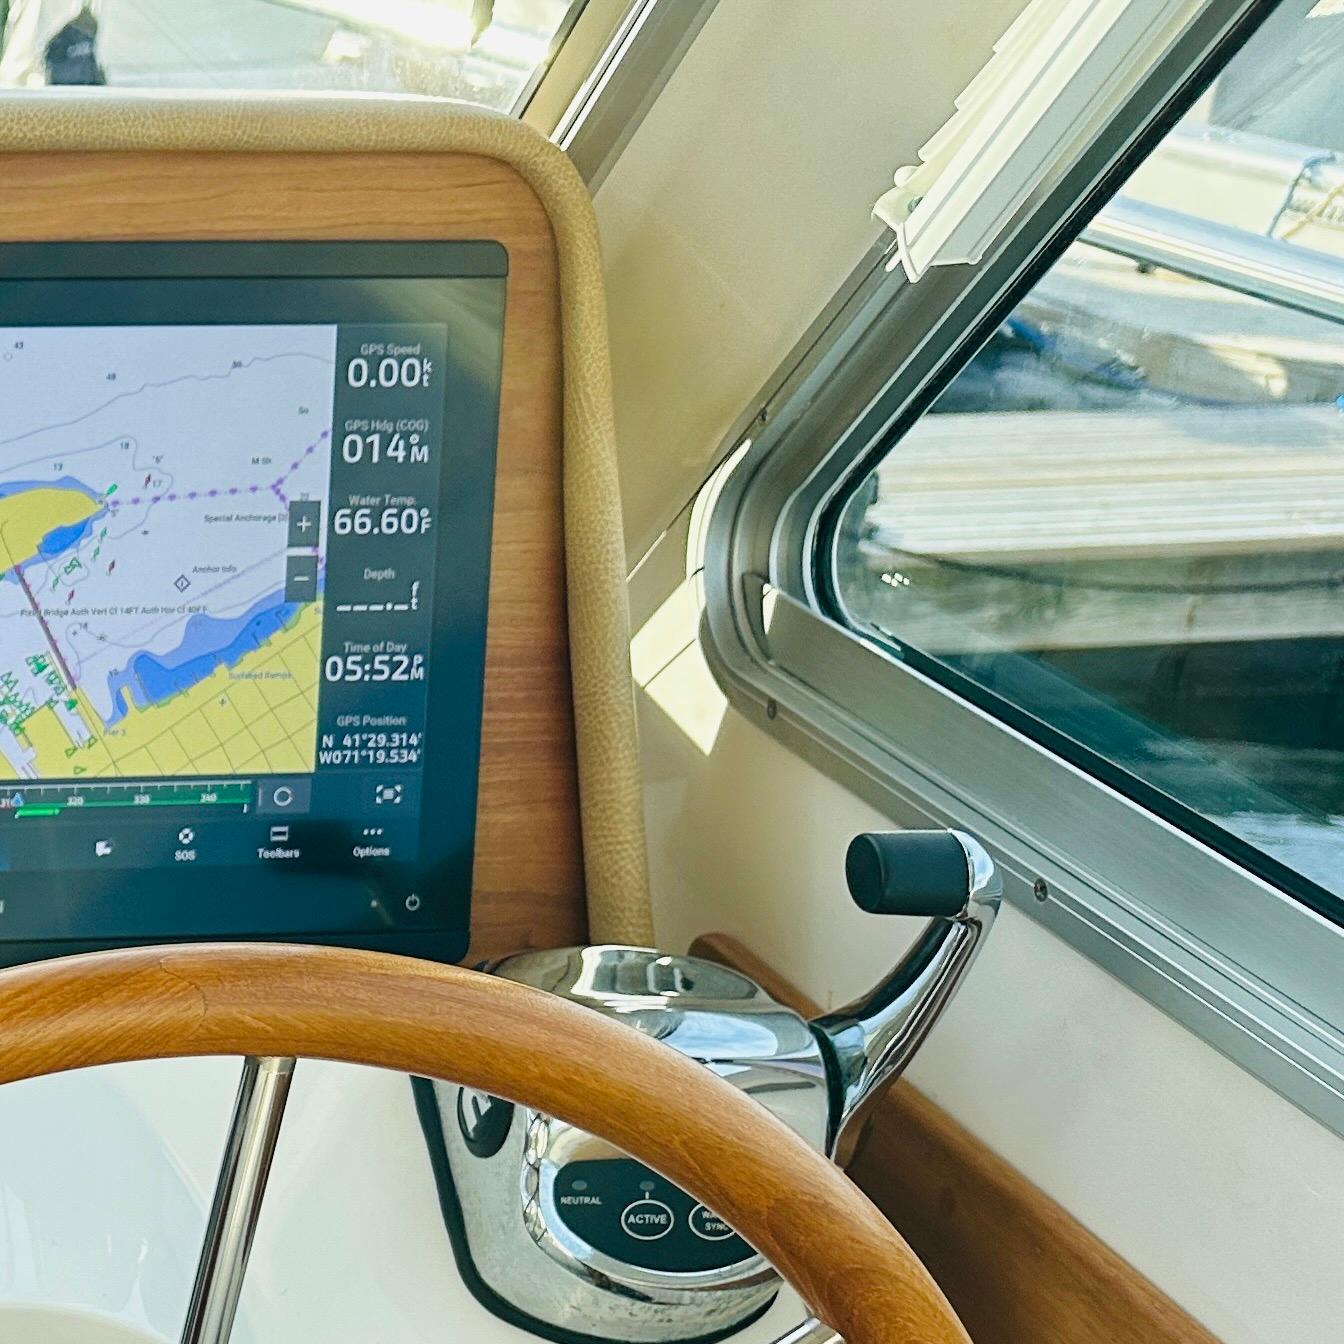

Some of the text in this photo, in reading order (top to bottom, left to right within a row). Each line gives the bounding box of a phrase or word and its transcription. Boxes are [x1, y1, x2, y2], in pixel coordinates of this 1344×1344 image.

[360, 342, 420, 358] GPS Speed
[347, 359, 421, 388] 0.00
[345, 418, 429, 437] GPS Hdg (COG)
[341, 434, 407, 464] 014
[348, 494, 415, 510] Water Temp.
[333, 508, 420, 536] 66.60
[363, 568, 395, 582] Depth
[343, 641, 407, 656] Time of Day
[324, 655, 410, 683] 05:52
[336, 714, 406, 728] GPS Position
[321, 734, 333, 748] N
[174, 849, 196, 861] SOS
[257, 847, 300, 860] Toolbars
[352, 845, 390, 859] Options
[560, 1196, 603, 1205] NEUTRAL
[627, 1213, 668, 1225] ACTIVE
